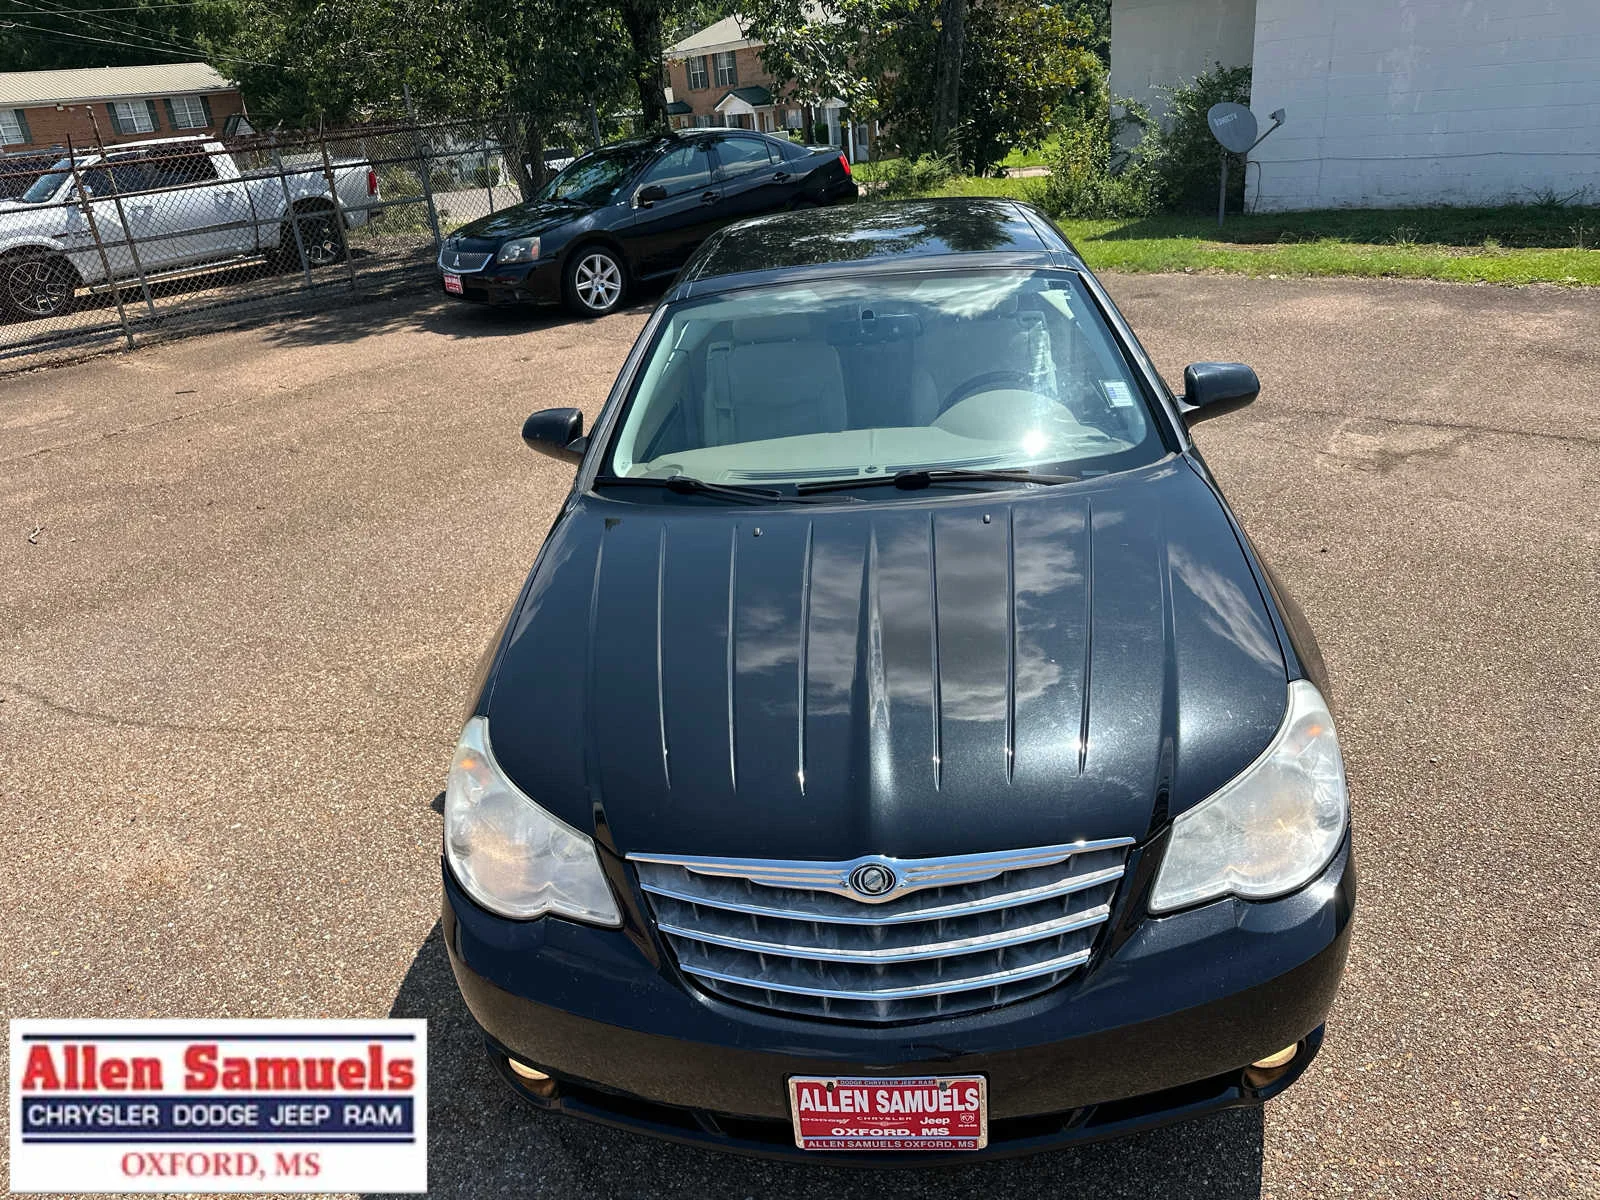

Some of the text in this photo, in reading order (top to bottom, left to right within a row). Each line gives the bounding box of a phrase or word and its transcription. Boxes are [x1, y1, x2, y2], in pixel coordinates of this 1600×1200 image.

[799, 1087, 980, 1114] ALLEN SAMUELS
[919, 1116, 951, 1125] Jeep
[831, 1127, 950, 1137] OXFORD, MS
[807, 1140, 975, 1149] ALLEN SAMUELS OXFORD, MS
